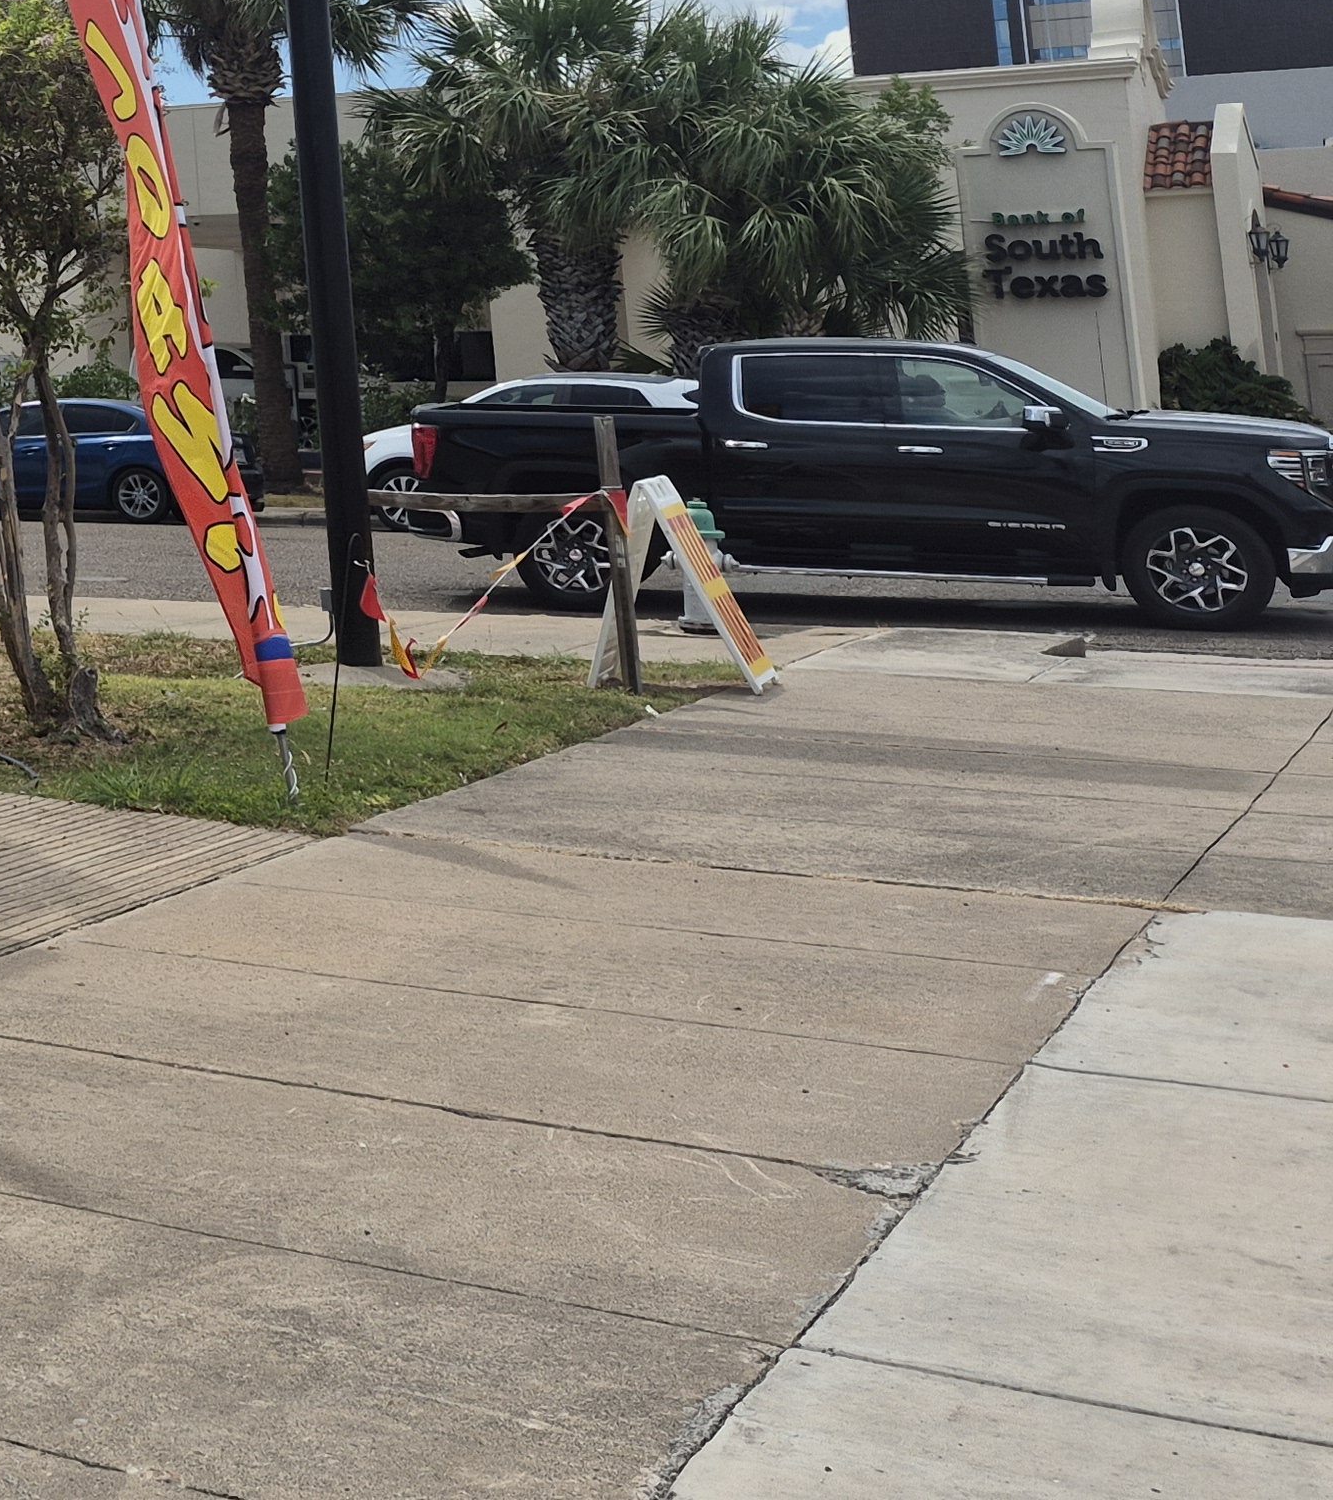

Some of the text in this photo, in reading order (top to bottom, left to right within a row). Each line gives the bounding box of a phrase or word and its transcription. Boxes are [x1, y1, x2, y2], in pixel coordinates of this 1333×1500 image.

[992, 208, 1084, 227] Bank of
[984, 231, 1104, 262] South
[982, 266, 1108, 299] Texas
